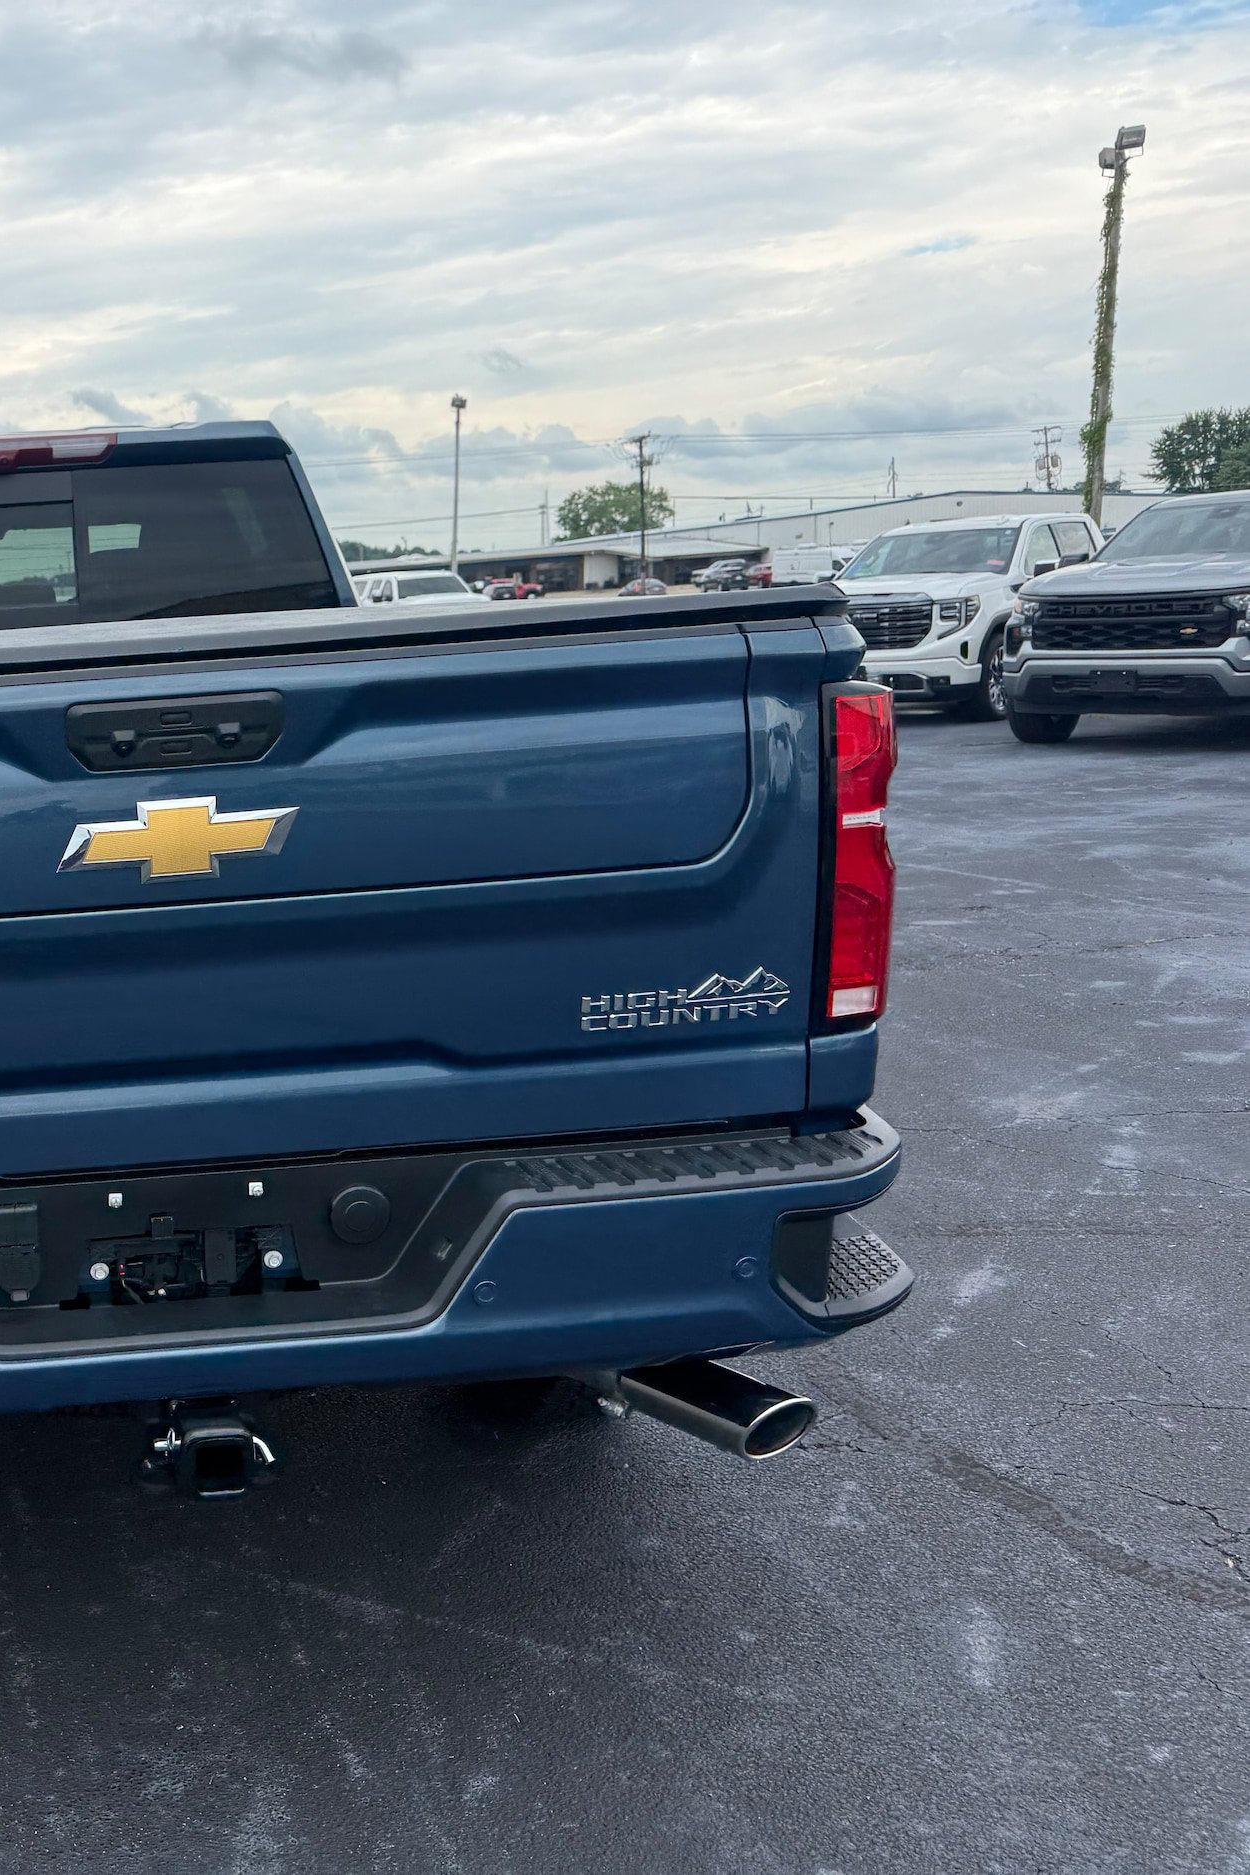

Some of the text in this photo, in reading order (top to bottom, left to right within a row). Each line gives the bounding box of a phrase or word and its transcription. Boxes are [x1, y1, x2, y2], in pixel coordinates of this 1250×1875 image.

[1045, 602, 1213, 615] CHEVROLET
[581, 988, 688, 1014] HIGH
[580, 997, 789, 1032] COUNTRY
